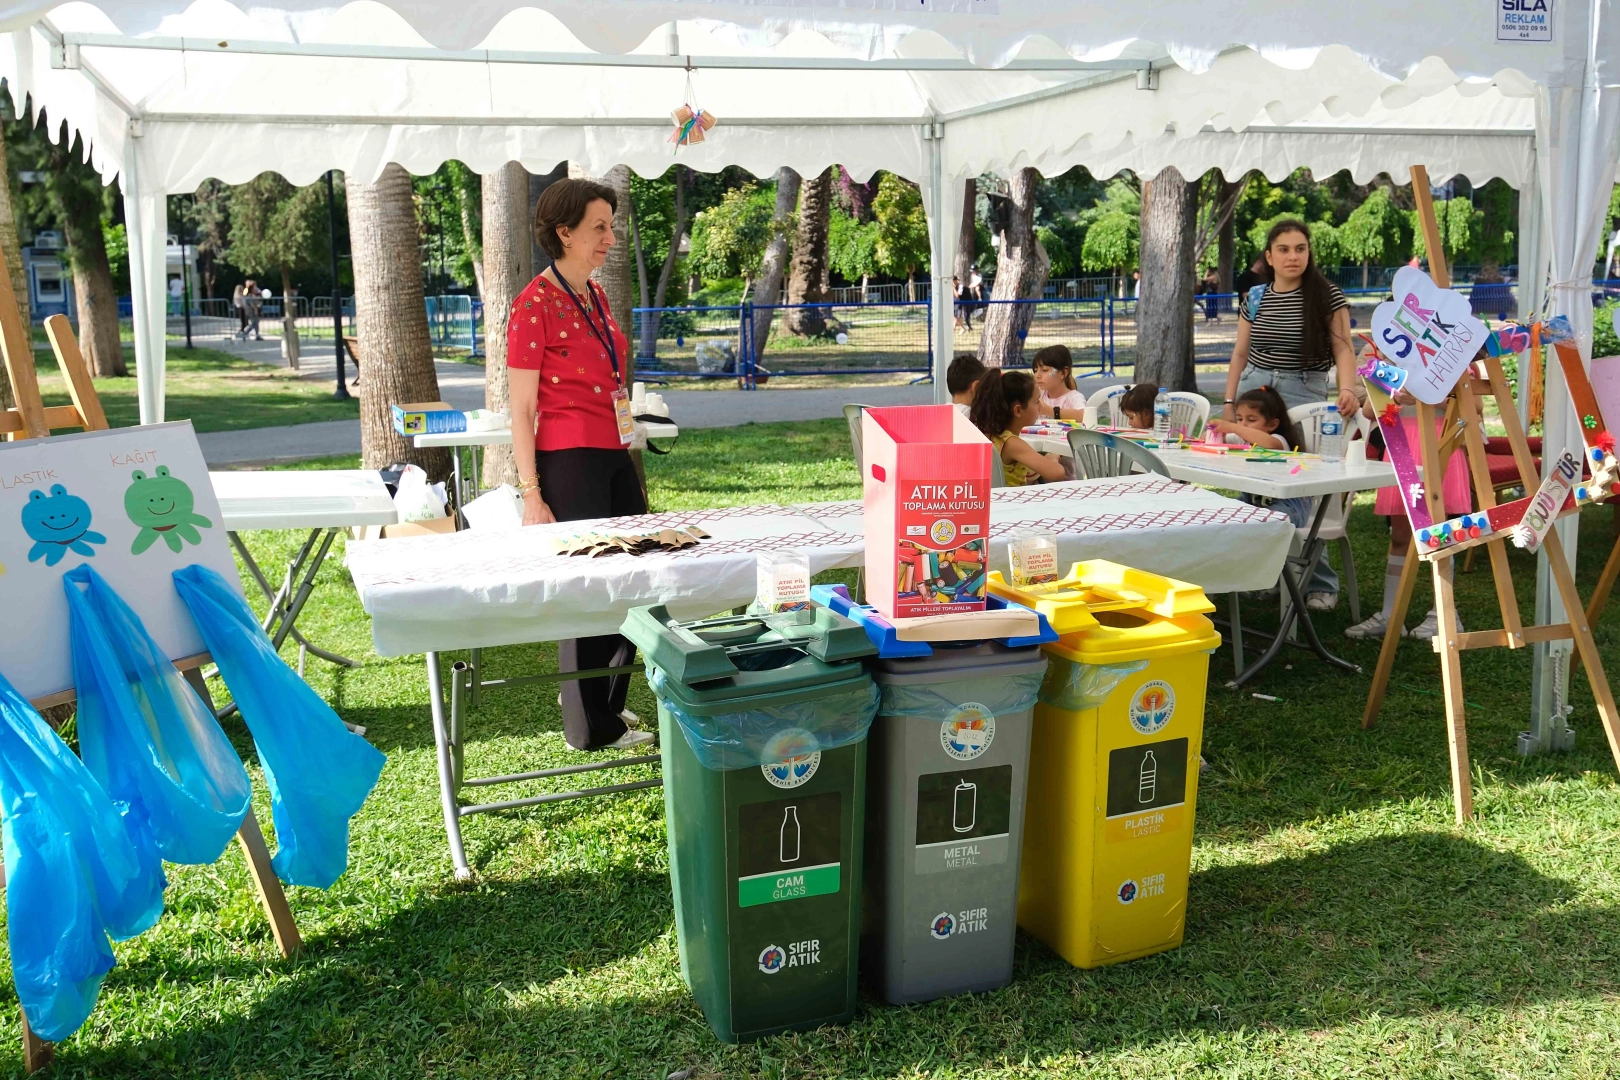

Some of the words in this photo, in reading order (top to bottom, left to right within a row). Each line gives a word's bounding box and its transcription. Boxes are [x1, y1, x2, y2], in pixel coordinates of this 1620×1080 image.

[1504, 13, 1545, 24] REKLAM
[1382, 292, 1435, 358] SIFIR
[1415, 311, 1455, 368] ATIK
[1425, 321, 1474, 390] HATIRASI
[109, 449, 157, 467] KAĞIT
[0, 467, 58, 490] LASTİK
[910, 485, 948, 500] ATIK
[953, 481, 978, 499] PİL
[903, 502, 946, 511] TOPLAMA
[948, 501, 985, 510] KUTUSU
[1125, 812, 1165, 830] PLASTİK
[944, 845, 980, 859] METAL
[946, 856, 978, 869] METAL
[776, 875, 804, 889] CAM
[1141, 873, 1165, 887] SIFIR
[772, 886, 806, 899] GLASS
[1140, 884, 1165, 899] ATIK
[959, 907, 988, 922] SIFIR
[957, 918, 988, 934] ATIK
[788, 939, 820, 955] SIFIR
[788, 951, 821, 968] ATIK
